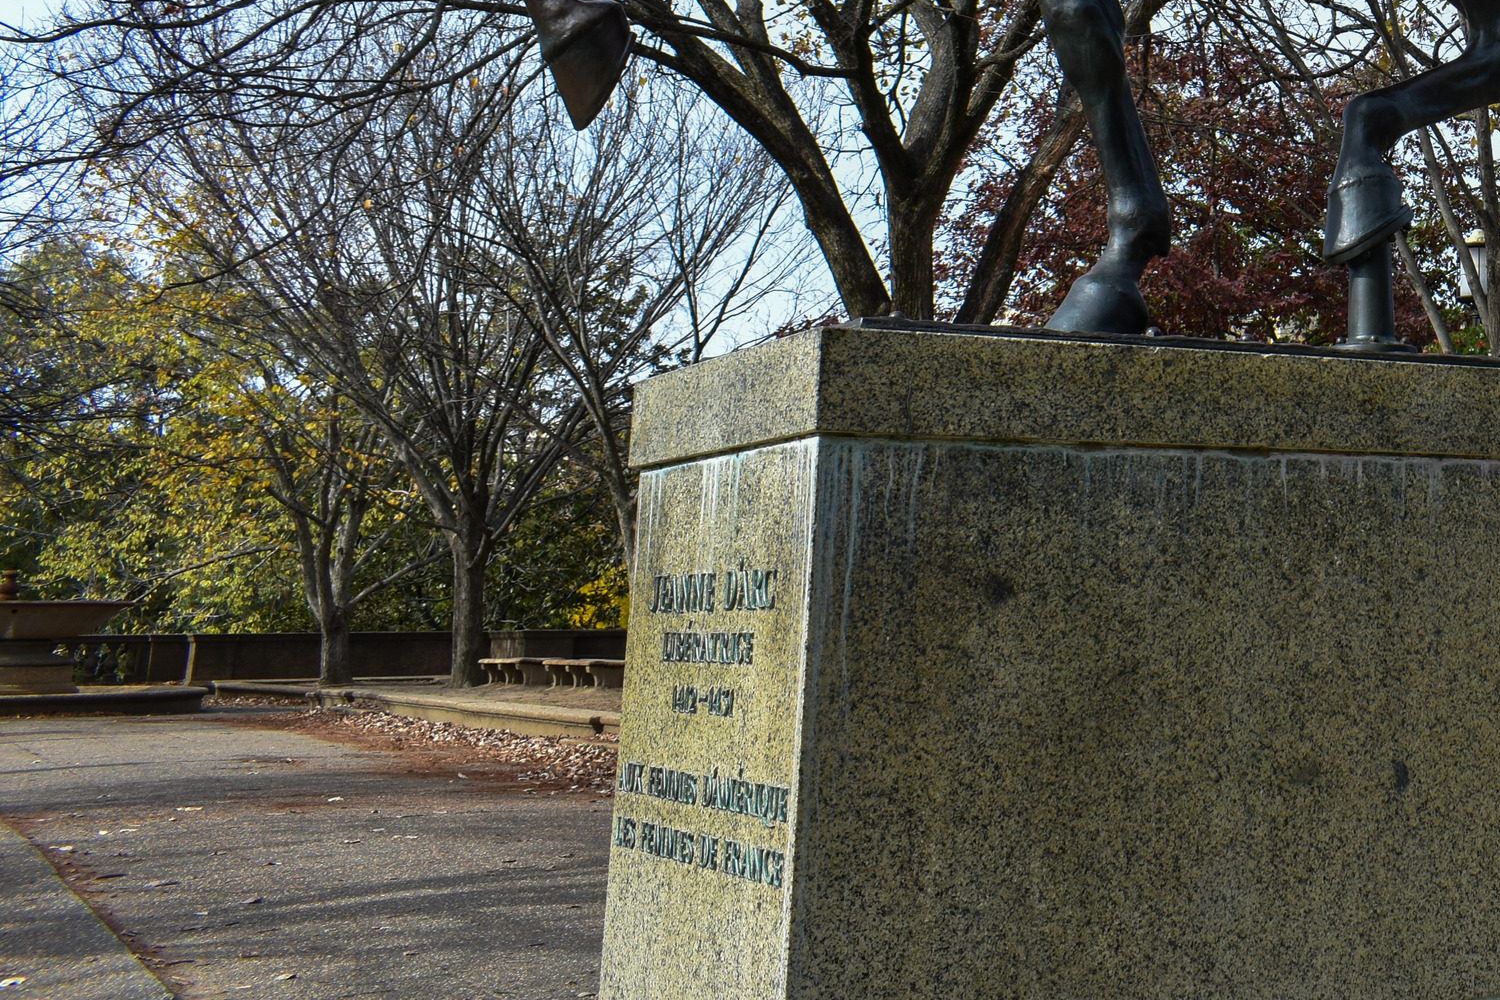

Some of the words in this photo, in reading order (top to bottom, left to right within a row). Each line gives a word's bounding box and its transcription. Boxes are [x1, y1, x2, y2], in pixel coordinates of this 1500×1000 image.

[649, 571, 717, 613] JEANNE
[724, 556, 777, 611] D'ARC
[662, 619, 755, 665] LIBÉRATRICE
[672, 684, 735, 718] 1412-1431
[618, 761, 645, 794] AUX
[648, 766, 699, 806] FEMMES
[702, 764, 789, 828] D'AMÉRIQUE
[615, 816, 637, 850] LES
[641, 820, 695, 865] FEMMES
[700, 833, 720, 871] DE
[723, 838, 784, 888] FRANCE
